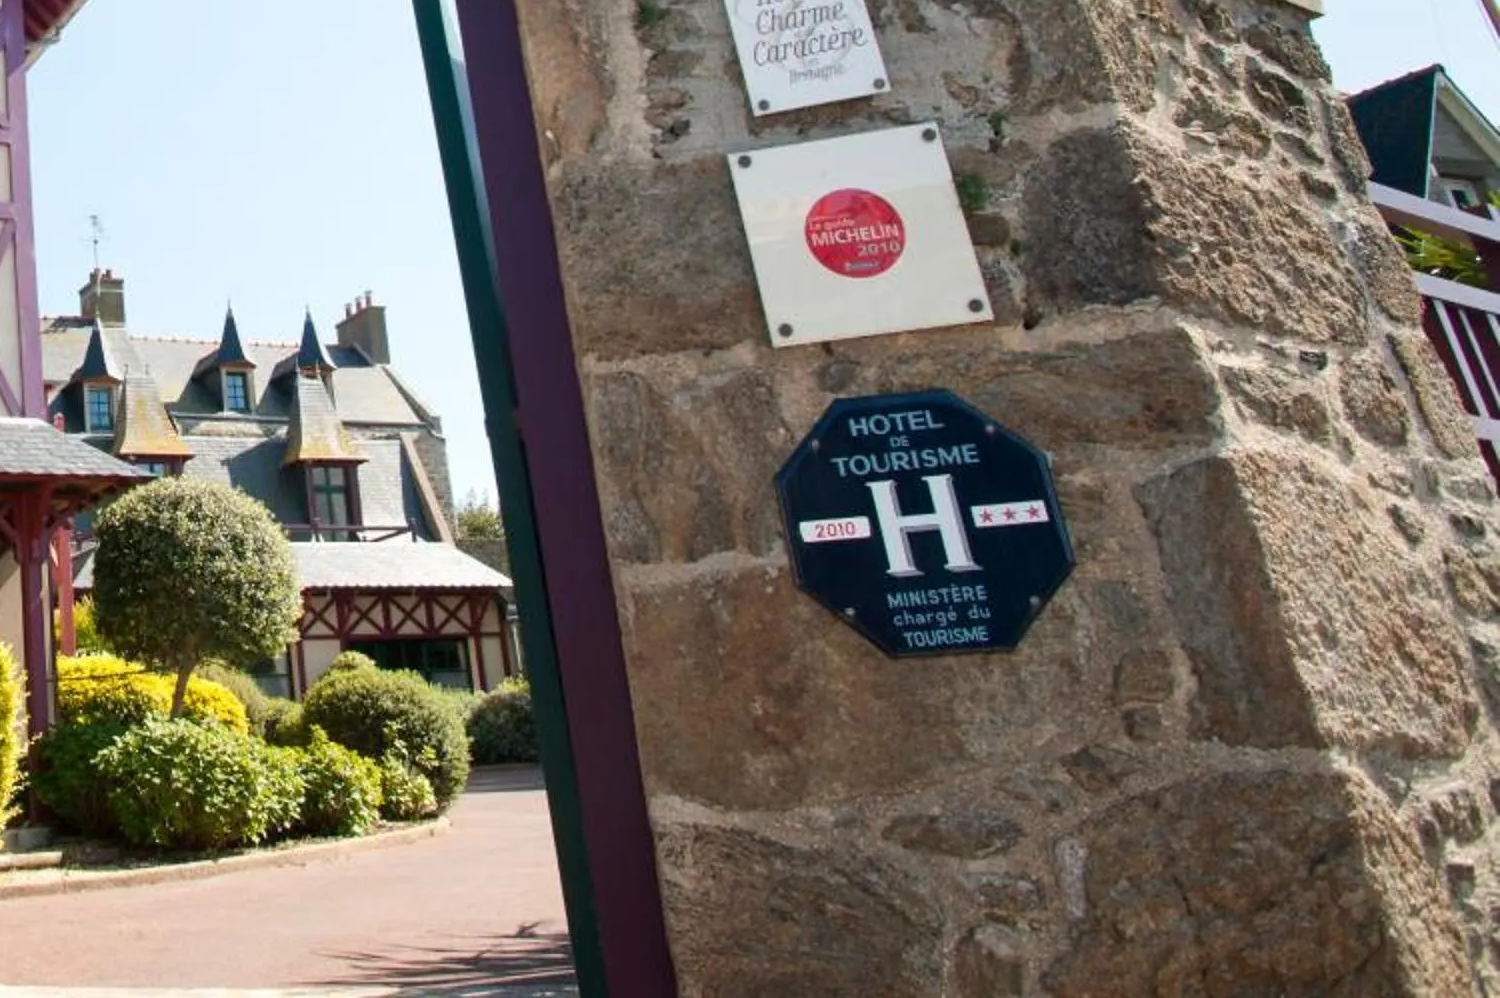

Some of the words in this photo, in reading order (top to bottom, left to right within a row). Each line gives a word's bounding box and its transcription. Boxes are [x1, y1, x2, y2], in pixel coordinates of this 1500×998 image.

[756, 1, 847, 35] Charme
[753, 25, 869, 67] Caractère
[811, 224, 899, 247] MICHELIN
[849, 410, 945, 437] HOTEL
[890, 435, 910, 447] DE
[830, 443, 981, 477] TOURISME
[814, 521, 856, 539] 2010
[865, 473, 983, 578] H
[887, 584, 989, 609] MINISTÈRE
[893, 606, 957, 627] chargé
[968, 602, 991, 620] du
[903, 625, 990, 649] TOURISME
